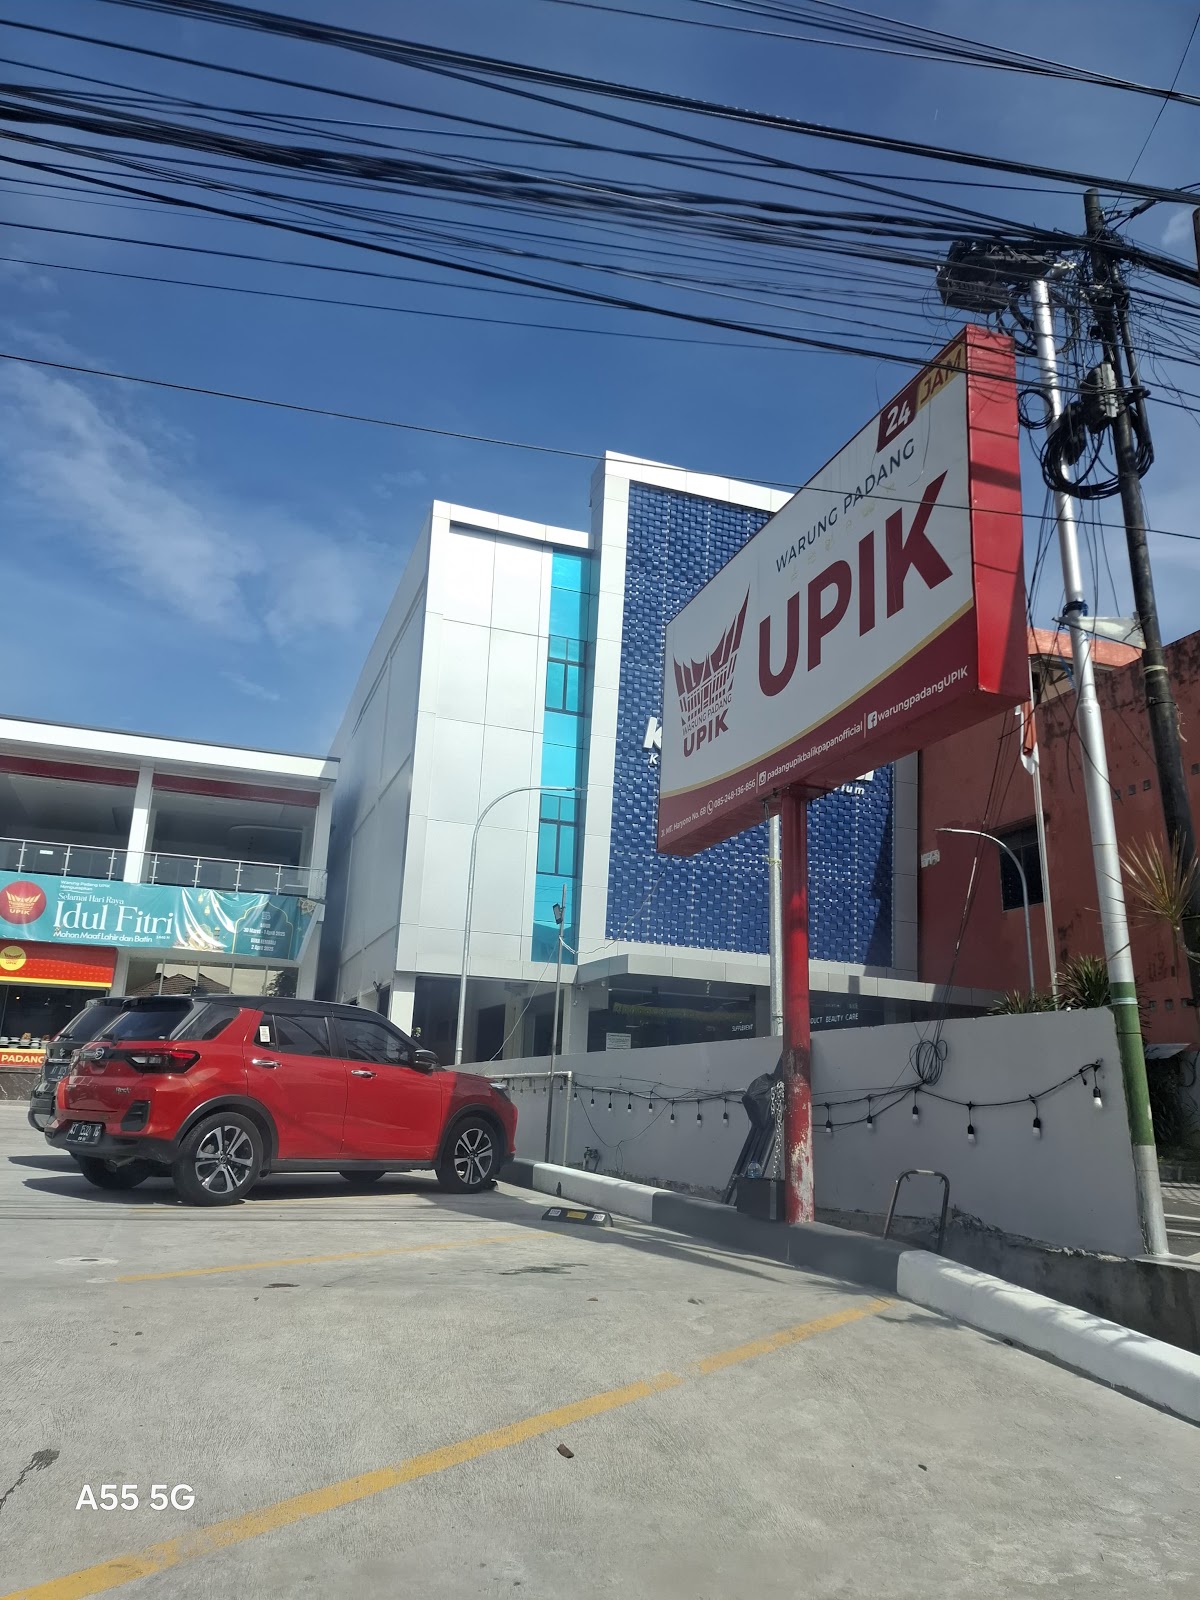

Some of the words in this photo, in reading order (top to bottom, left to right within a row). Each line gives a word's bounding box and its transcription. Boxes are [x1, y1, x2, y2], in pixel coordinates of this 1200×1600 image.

[885, 400, 911, 437] 24
[920, 348, 962, 404] JAM
[776, 507, 838, 573] WARUNG
[843, 438, 915, 518] PADANG
[758, 469, 954, 697] UPIK
[682, 713, 707, 736] WARUNG
[707, 693, 732, 719] PADANG
[877, 665, 968, 722] warungpadangUPIK
[683, 708, 729, 758] UPIK
[767, 720, 863, 782] padangupikbalikpapanofficial
[673, 816, 691, 831] Haryono
[53, 900, 108, 931] Idul
[115, 905, 174, 935] Fitri
[58, 892, 87, 902] Selamat
[88, 894, 104, 903] Hari
[106, 896, 124, 906] Raya
[53, 931, 80, 939] Mohon
[80, 932, 102, 940] Maaf
[101, 933, 118, 941] Lahir
[810, 1016, 823, 1024] DUCT
